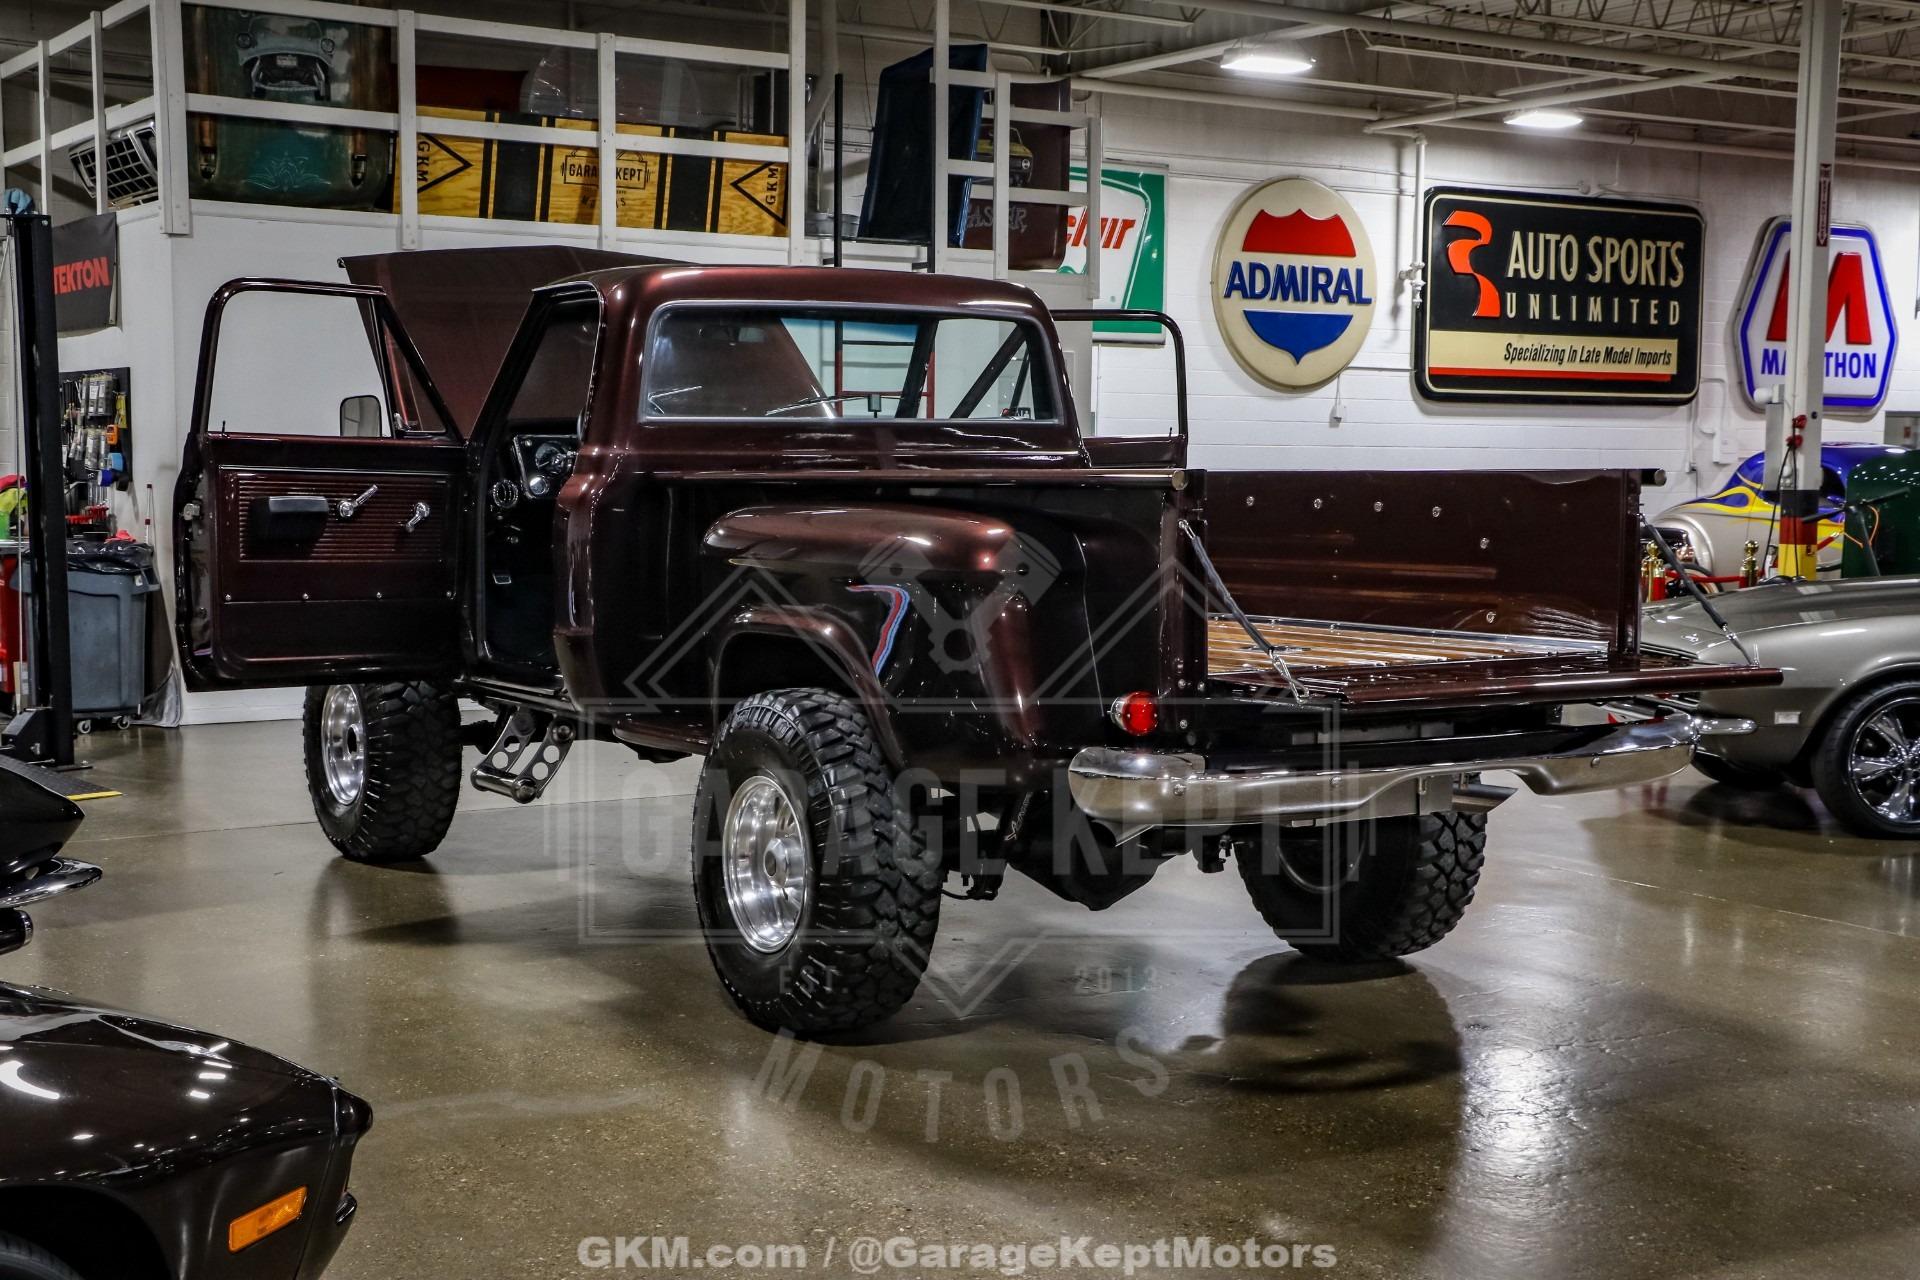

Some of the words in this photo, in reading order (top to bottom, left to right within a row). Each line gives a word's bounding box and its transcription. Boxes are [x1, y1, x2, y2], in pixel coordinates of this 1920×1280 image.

[417, 140, 430, 182] GKM
[616, 166, 643, 181] KEPT
[765, 166, 779, 206] GKM
[54, 257, 110, 294] TEKTON
[1506, 230, 1580, 283] AUTO
[1587, 235, 1685, 288] SPORTS
[1224, 260, 1373, 305] ADMIRAL
[1505, 291, 1682, 326] UNLIMITED
[1504, 342, 1565, 364] Specializing
[1567, 345, 1578, 361] In
[1579, 345, 1601, 363] Late
[1603, 346, 1633, 365] Model
[1635, 348, 1672, 367] Imports
[1760, 348, 1877, 379] MTHON
